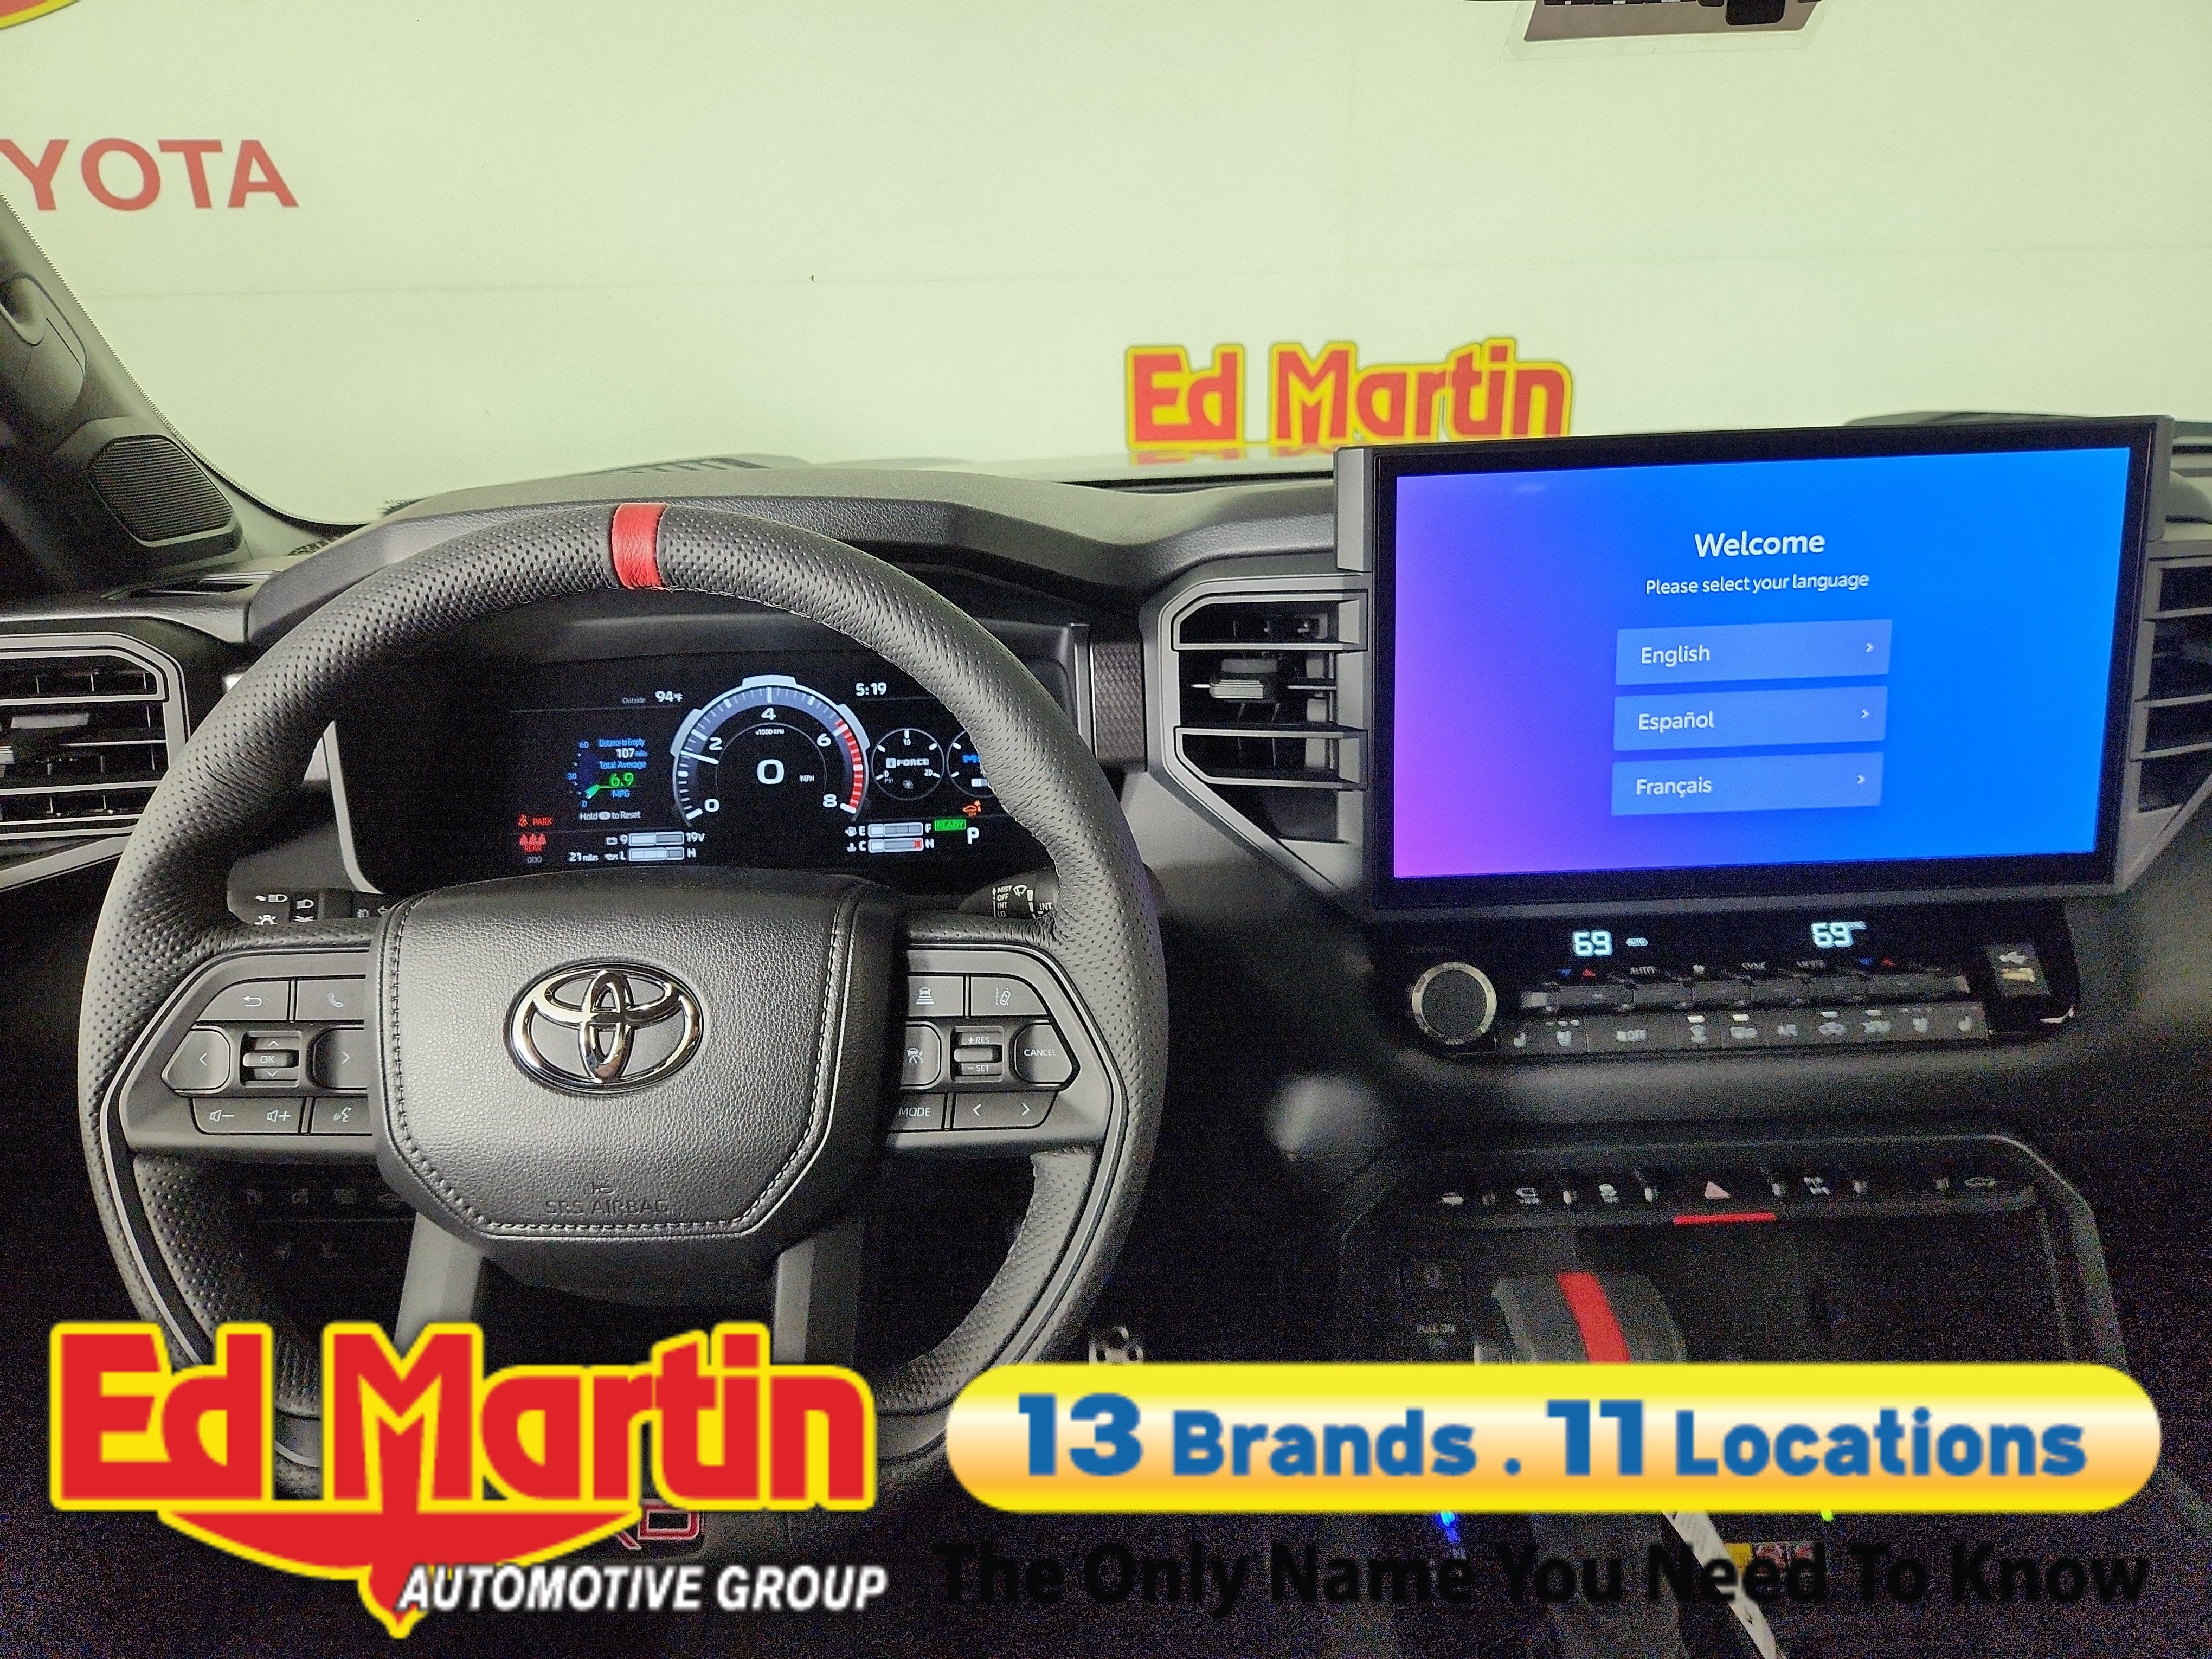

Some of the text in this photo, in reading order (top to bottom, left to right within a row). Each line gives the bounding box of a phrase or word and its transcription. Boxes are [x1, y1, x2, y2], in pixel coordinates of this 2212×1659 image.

[1127, 337, 1572, 449] Ed Martin
[1694, 530, 1825, 557] Welcome
[1645, 573, 1870, 595] Please select your language
[1641, 644, 1711, 668] English
[856, 682, 887, 696] 5:19
[622, 695, 646, 704] Outside
[761, 707, 776, 720] 4
[1638, 710, 1714, 734] Español
[580, 740, 589, 749] 60
[599, 739, 621, 747] Distance
[628, 738, 645, 748] Empty
[709, 737, 723, 750] 2
[816, 733, 831, 747] 6
[615, 748, 635, 758] 107
[599, 761, 647, 770] Total Average
[757, 759, 785, 785] 0
[924, 768, 933, 776] 20
[568, 772, 577, 780] 30
[609, 771, 634, 786] 6.9
[611, 789, 631, 798] MPG
[1636, 776, 1712, 798] Français
[581, 800, 587, 808] 0
[704, 799, 719, 812] 0
[822, 794, 837, 808] 8
[533, 817, 552, 826] PARK
[580, 812, 598, 821] Hold
[620, 811, 641, 819] Reset
[858, 823, 932, 837] E F
[936, 820, 964, 829] READY
[619, 832, 705, 845] 9 19V
[967, 827, 980, 845] P
[858, 838, 934, 852] C H
[569, 852, 582, 862] 21
[619, 848, 696, 861] L H
[997, 885, 1012, 893] MIST
[997, 893, 1009, 901] OFF
[997, 901, 1008, 909] INT
[1039, 902, 1052, 910] INT
[1811, 922, 1853, 948] 69
[1573, 930, 1613, 956] 69
[1024, 1048, 1056, 1056] CANCEL
[260, 1055, 275, 1064] OK
[899, 1107, 931, 1117] MODE
[545, 1199, 670, 1215] SRS AIRBAG
